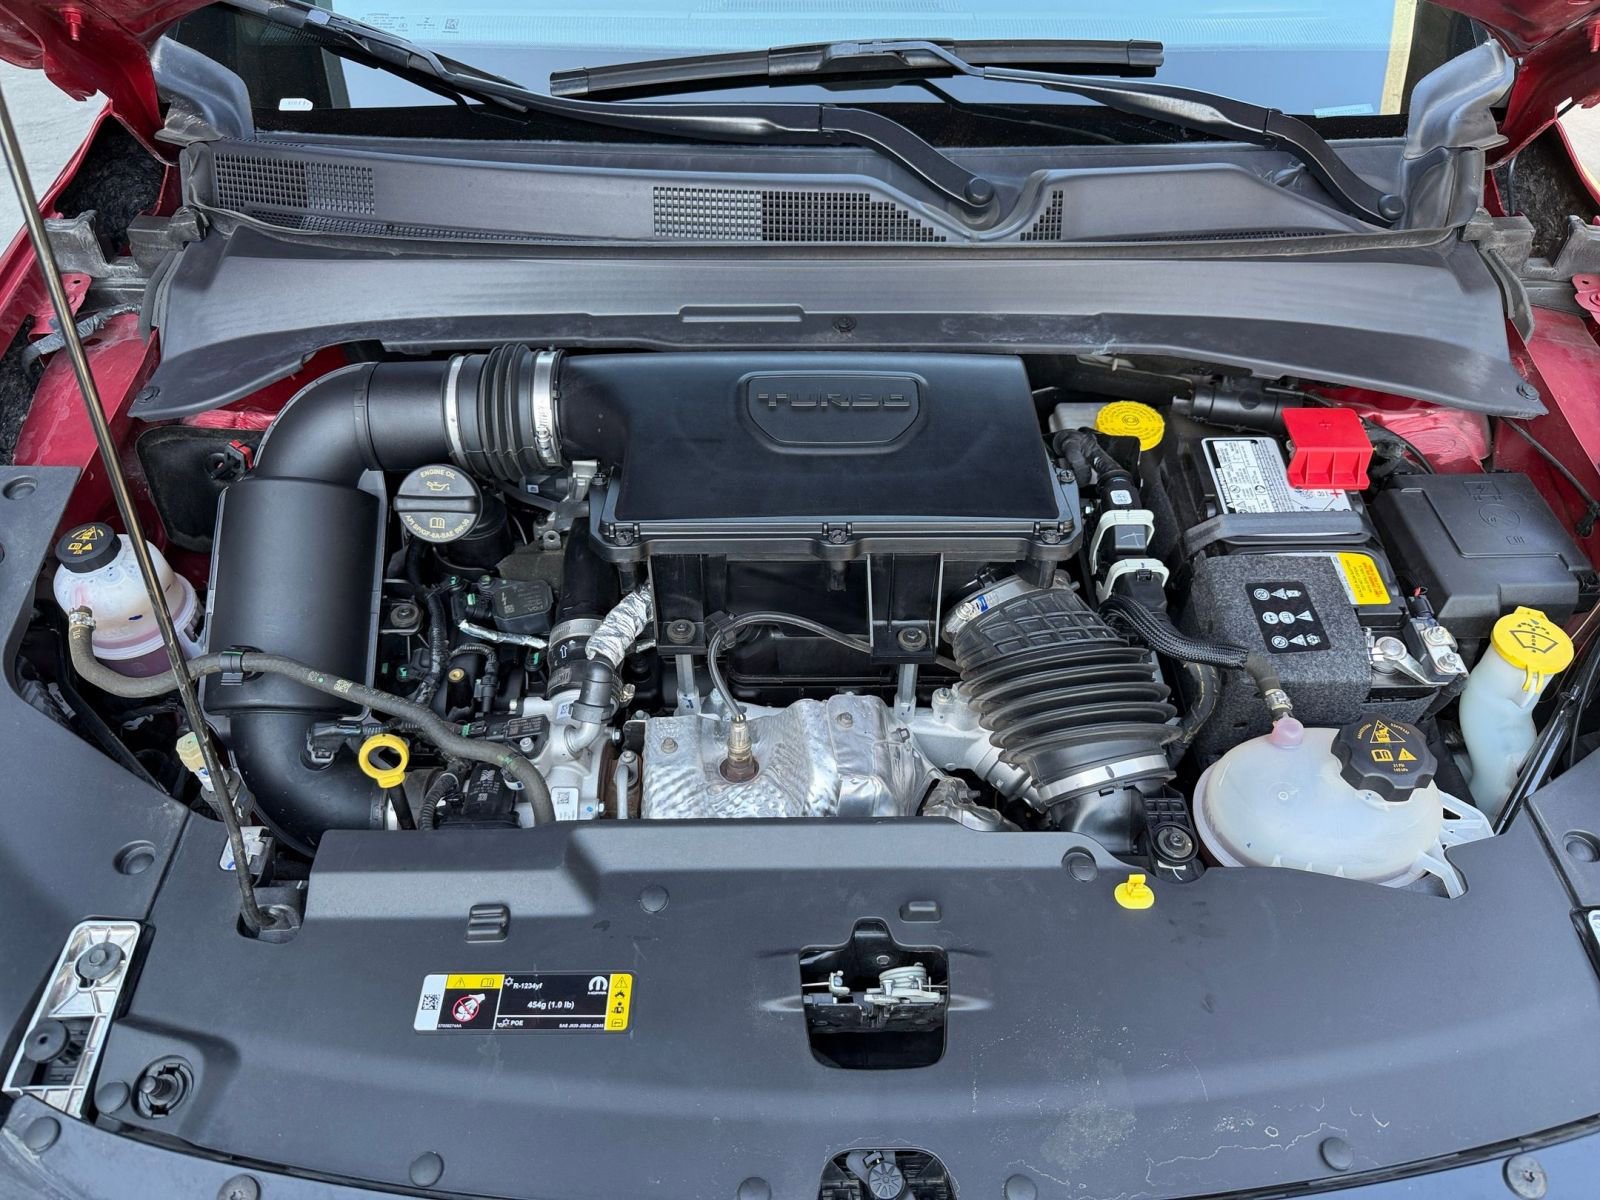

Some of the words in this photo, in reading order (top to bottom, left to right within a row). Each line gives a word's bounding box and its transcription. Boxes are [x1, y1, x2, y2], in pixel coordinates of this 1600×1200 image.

[757, 391, 911, 408] TURBO
[421, 469, 444, 478] ENGINE
[445, 470, 456, 480] OIL
[405, 515, 415, 525] API
[513, 982, 543, 991] R-1234yf
[527, 1001, 546, 1010] 454g
[548, 1001, 562, 1010] (1.0
[563, 1001, 574, 1010] lb)
[510, 1019, 524, 1027] POE
